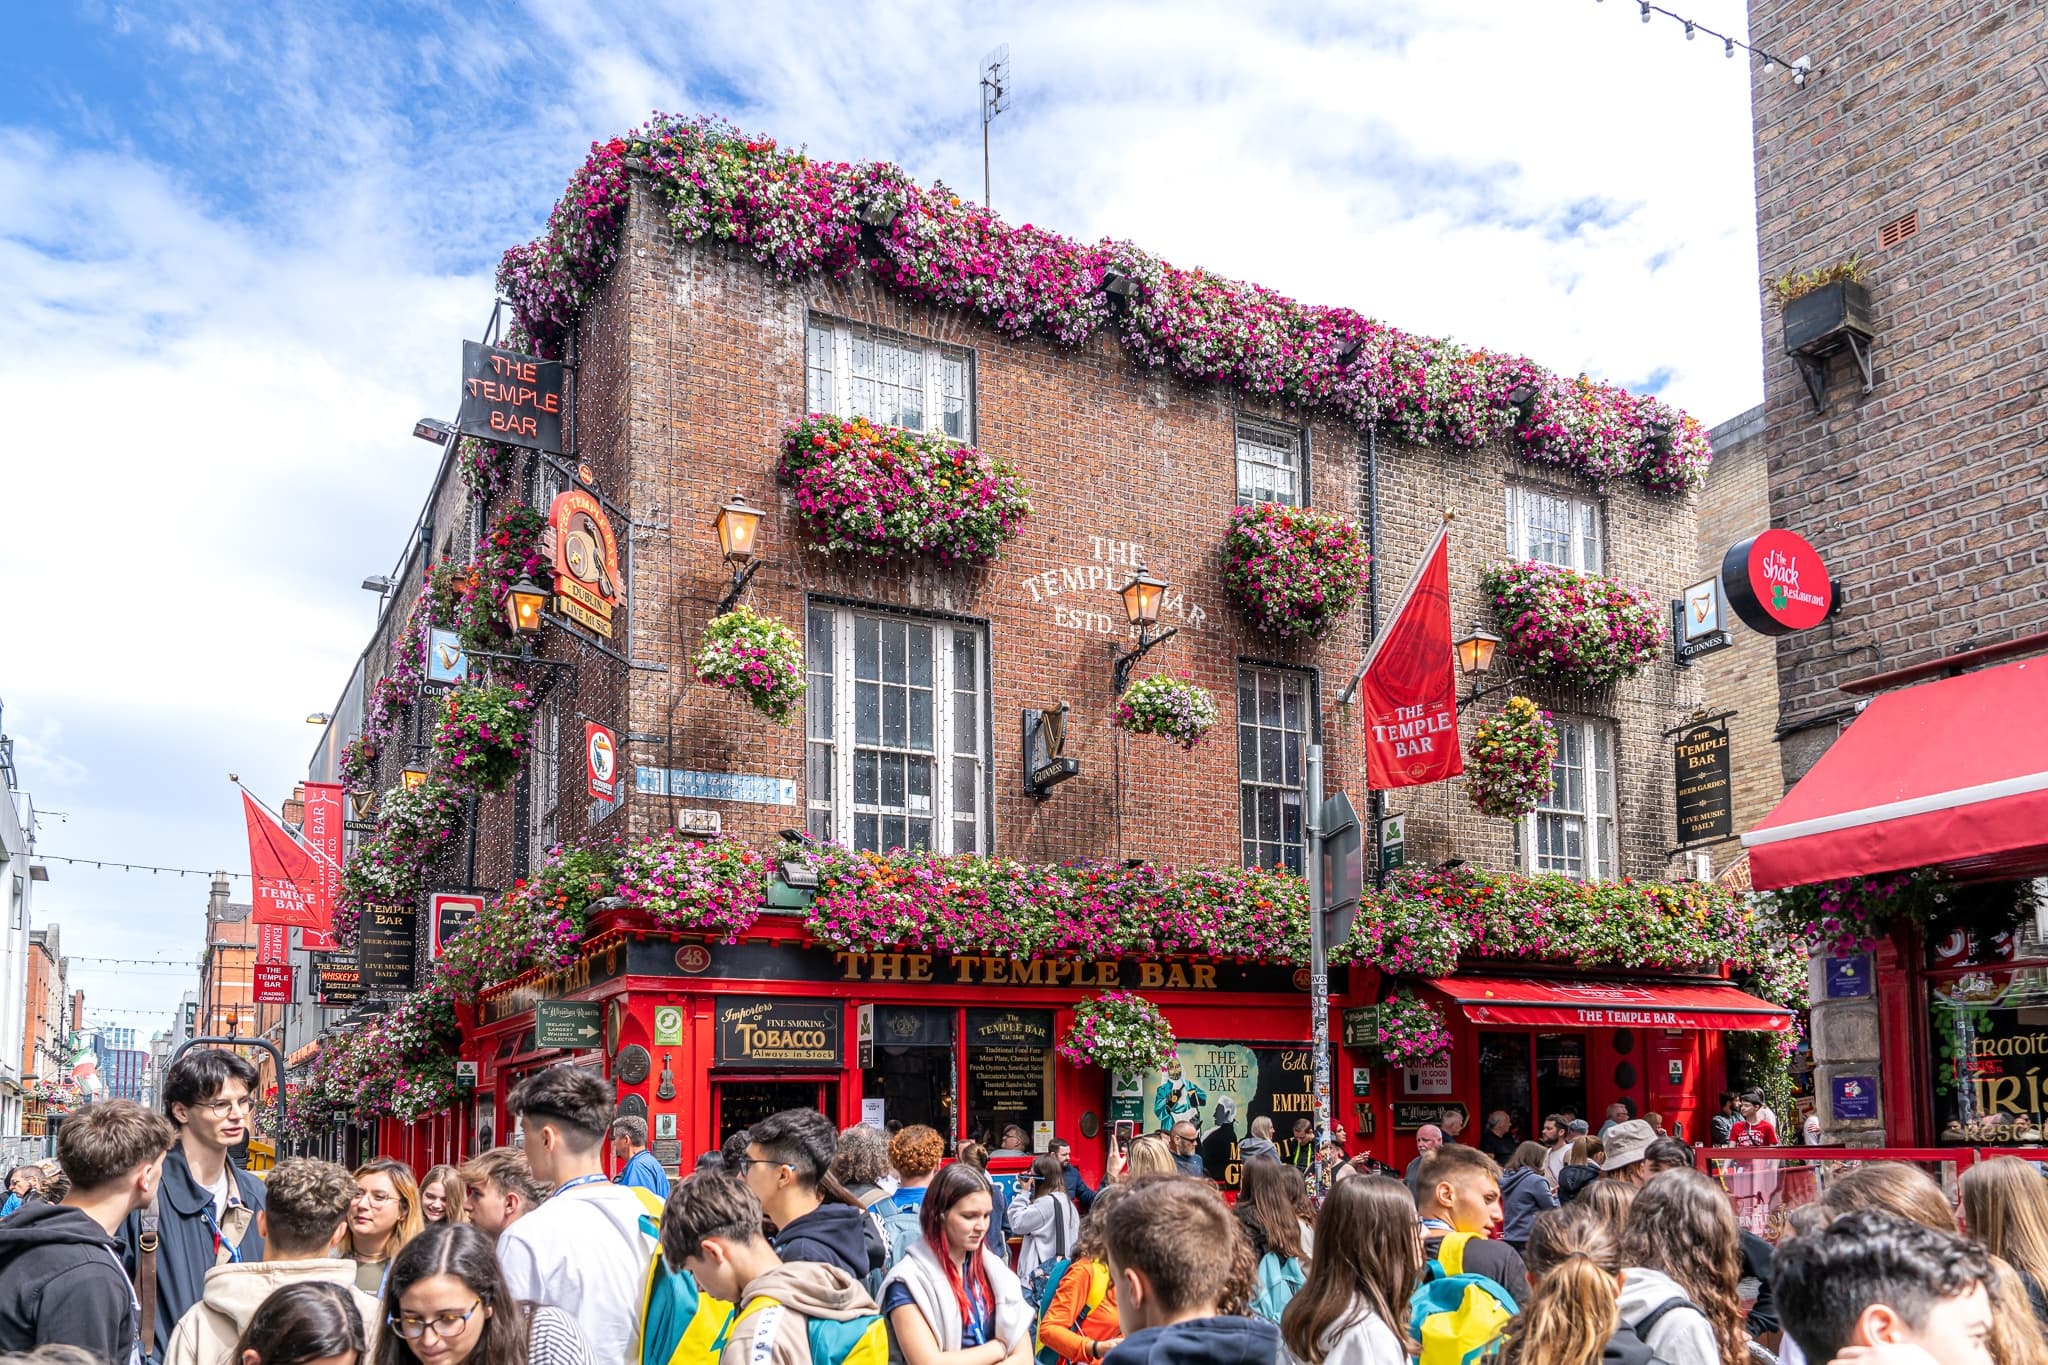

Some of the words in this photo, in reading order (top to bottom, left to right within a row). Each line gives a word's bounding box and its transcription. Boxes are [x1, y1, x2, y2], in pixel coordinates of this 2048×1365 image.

[491, 355, 536, 382] THE
[467, 378, 559, 413] TEMPLE
[491, 411, 537, 438] BAR
[559, 504, 571, 535] THE
[569, 497, 604, 530] TEMPLE
[605, 533, 614, 568] BAR
[1088, 536, 1144, 566] THE
[1776, 552, 1787, 565] The
[1763, 550, 1799, 588] Shack
[572, 585, 604, 611] DUBLIN
[1783, 585, 1825, 607] Restaurant
[566, 601, 583, 619] LIVE
[585, 613, 608, 634] MUSIC
[1684, 636, 1723, 656] GUINNESS
[1395, 704, 1424, 721] THE
[1372, 712, 1453, 743] TEMPLE
[1692, 730, 1710, 741] THE
[1395, 737, 1434, 758] BAR
[1677, 737, 1728, 757] TEMPLE
[1689, 754, 1716, 769] BAR
[1034, 762, 1063, 783] GUINNESS
[1679, 786, 1697, 796] BEER
[1698, 779, 1727, 792] GARDEN
[313, 807, 325, 834] BAR
[1682, 815, 1700, 825] LIVE
[1701, 809, 1726, 820] MUSIC
[1691, 821, 1716, 832] DAILY
[275, 899, 305, 911] BAR
[363, 902, 415, 915] TEMPLE
[375, 915, 402, 925] BAR
[263, 924, 271, 951] RADING
[273, 926, 282, 963] EMPLE
[681, 950, 703, 966] 48
[321, 972, 351, 980] WHISKEY
[836, 951, 933, 982] THE
[952, 956, 1121, 987] TEMPLE
[1139, 962, 1217, 989] BAR
[721, 1002, 773, 1024] Importers
[1577, 1009, 1603, 1022] THE
[1606, 1010, 1651, 1023] TEMPLE
[1654, 1012, 1676, 1024] BAR
[767, 1019, 786, 1027] FINE
[787, 1019, 825, 1028] SMOKING
[979, 1023, 1022, 1036] TEMPLE
[1024, 1024, 1046, 1038] BAR
[734, 1023, 826, 1056] TOBACCO
[754, 1050, 789, 1058] Always
[806, 1050, 833, 1058] Stock
[985, 1046, 1013, 1054] Traditional
[1208, 1051, 1236, 1064] THE
[1194, 1065, 1249, 1079] TEMPLE
[1208, 1079, 1237, 1092] BAR
